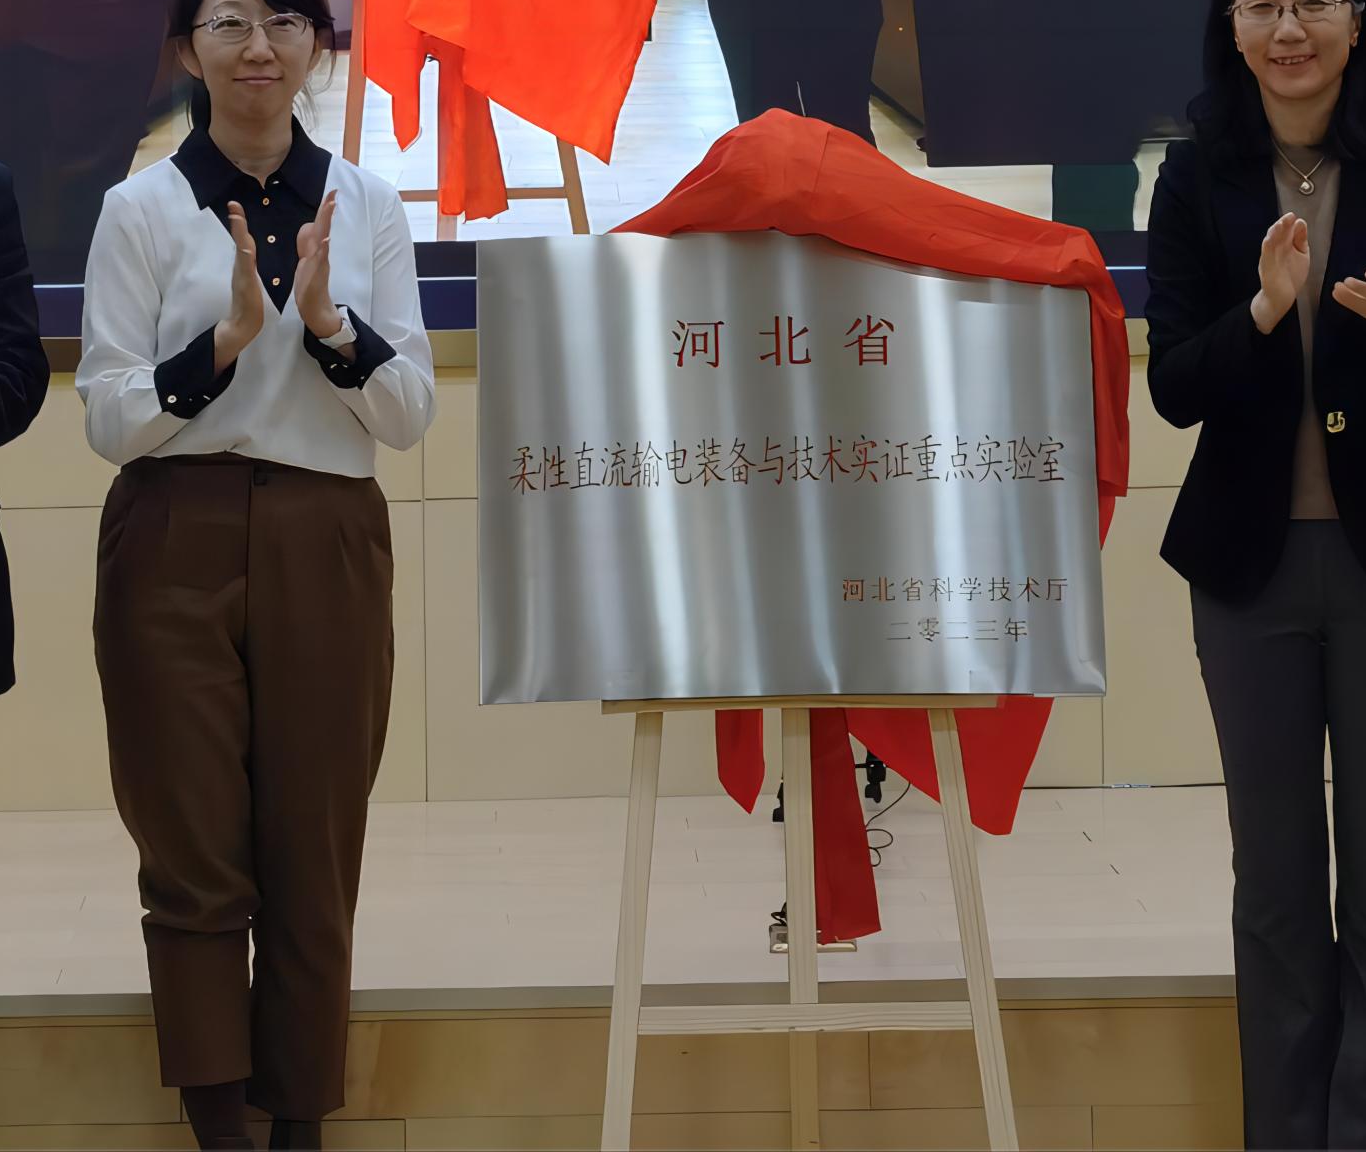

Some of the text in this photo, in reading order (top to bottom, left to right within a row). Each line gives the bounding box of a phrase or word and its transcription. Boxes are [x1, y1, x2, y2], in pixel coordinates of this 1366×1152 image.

[672, 315, 895, 368] 河北省
[508, 434, 1065, 495] 柔性直流输电装备与技术实证重点实验室
[842, 576, 1068, 602] 河北省科学技术厅
[886, 617, 1028, 642] 二零二三年
